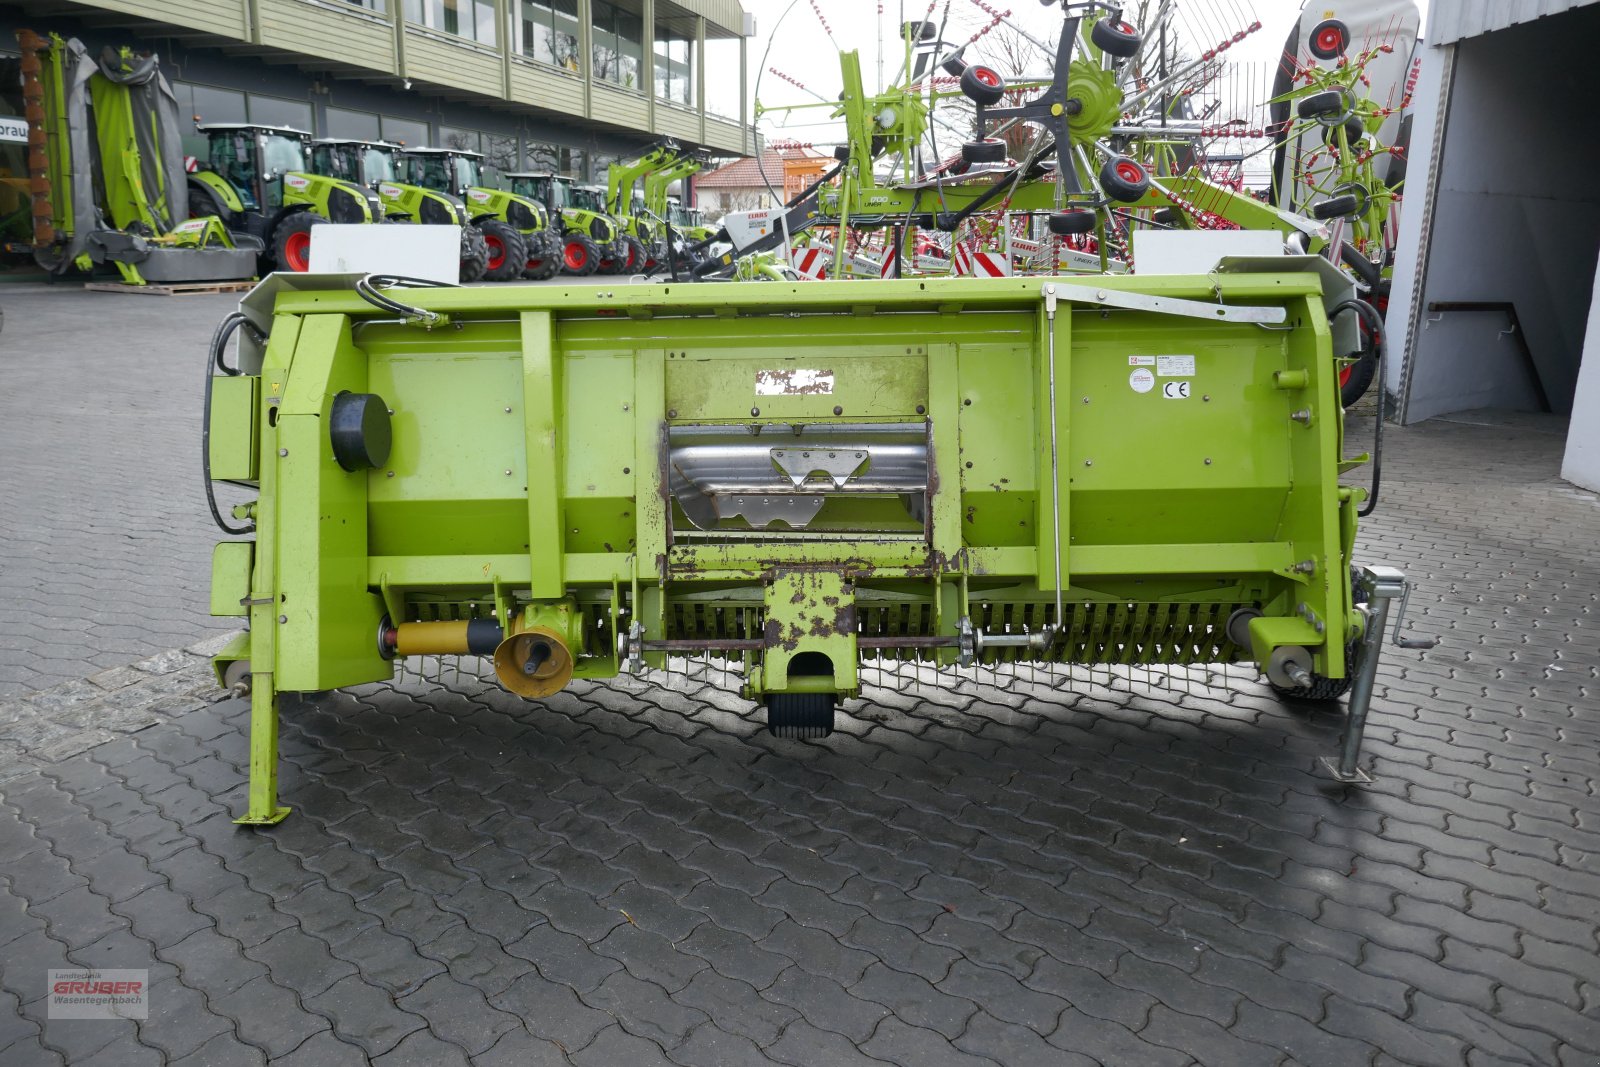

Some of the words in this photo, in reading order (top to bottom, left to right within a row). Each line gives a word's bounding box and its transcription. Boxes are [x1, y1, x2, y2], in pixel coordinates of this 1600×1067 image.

[748, 211, 768, 219] CLAAS
[1011, 241, 1038, 252] CLAAS
[1165, 382, 1187, 397] CE
